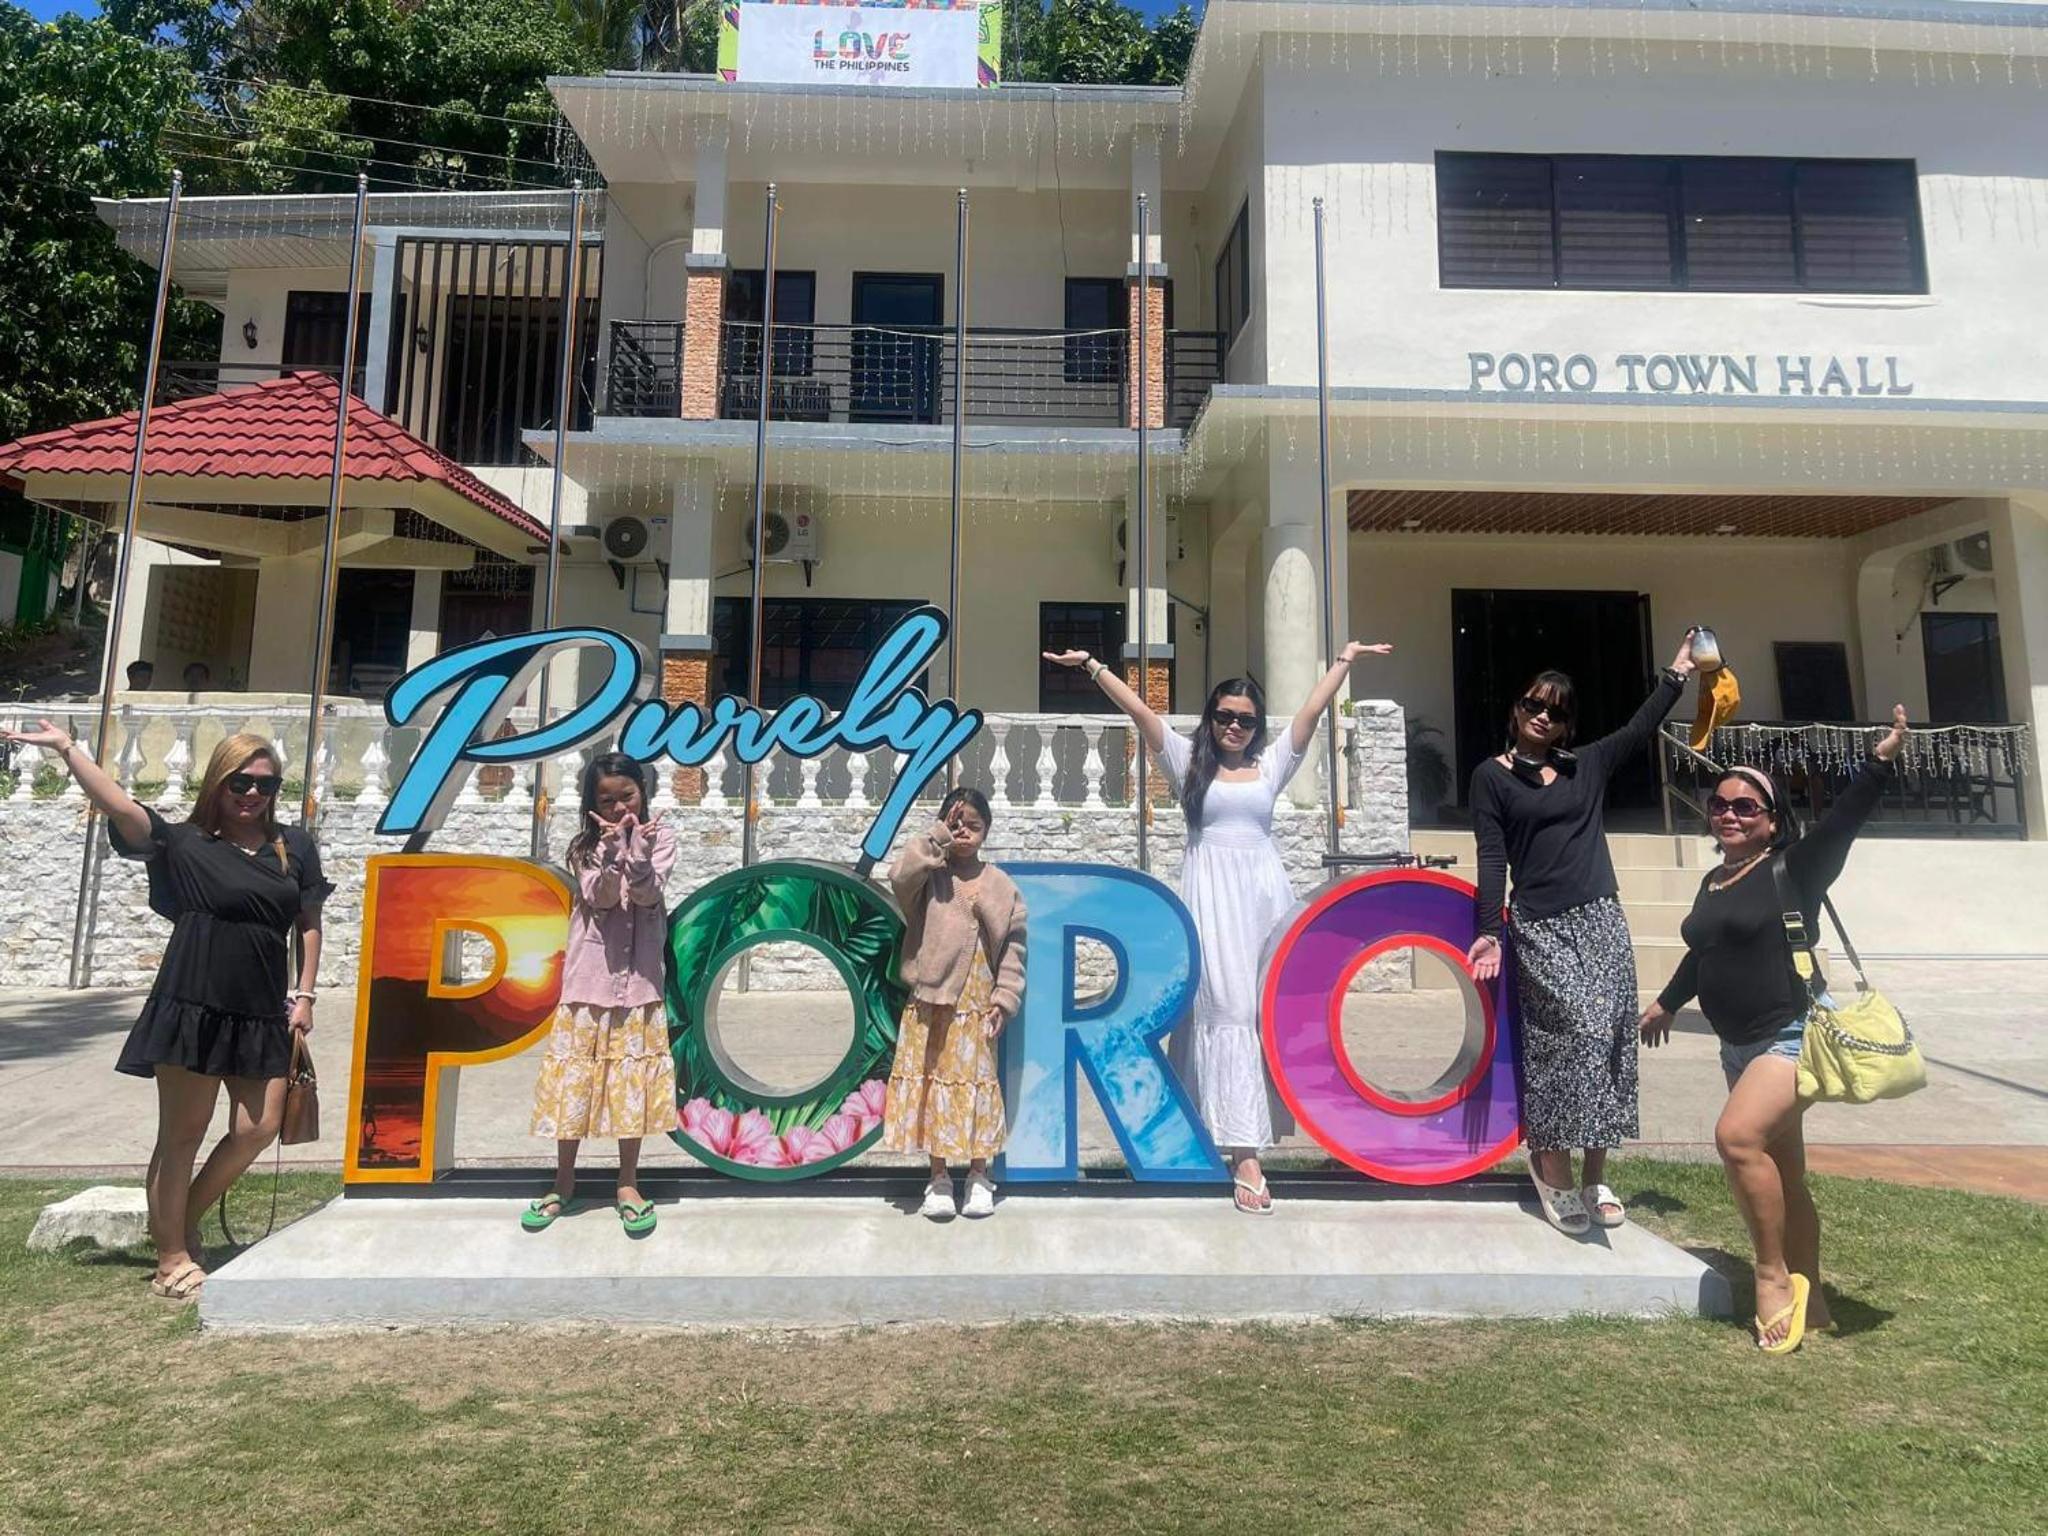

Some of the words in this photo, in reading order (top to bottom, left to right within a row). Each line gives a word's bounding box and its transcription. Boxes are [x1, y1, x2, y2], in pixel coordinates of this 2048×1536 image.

[813, 30, 911, 60] LOVE
[814, 60, 836, 70] THE
[839, 61, 910, 72] PHILIPPINES
[1468, 352, 1598, 392] PORO
[1615, 354, 1758, 393] TOWN
[1776, 356, 1914, 396] HALL
[375, 605, 983, 861] Purely
[344, 855, 1522, 1185] PORO
